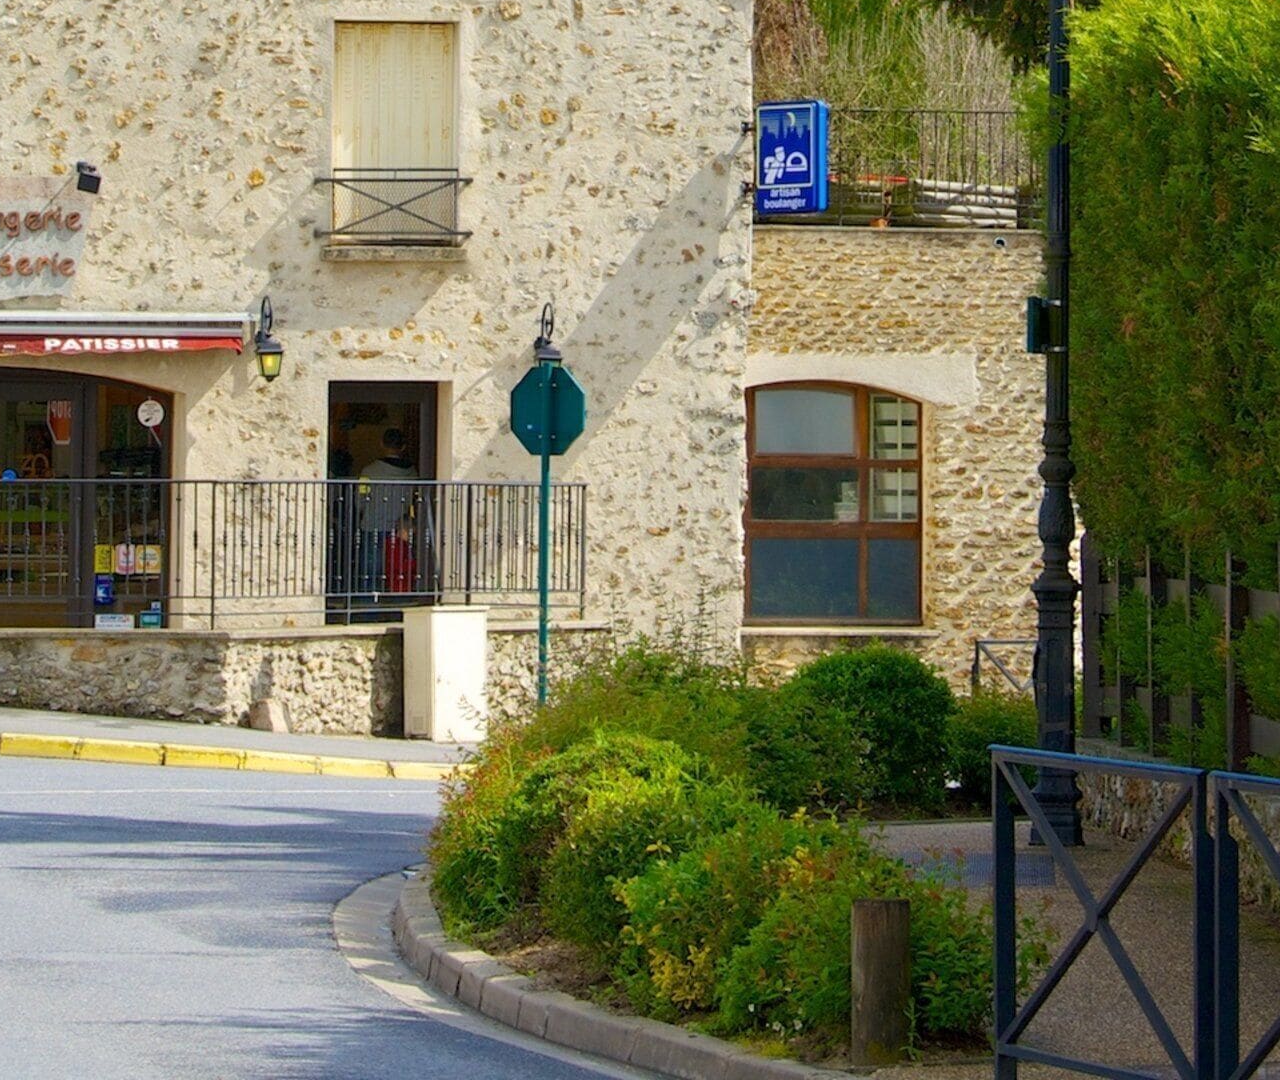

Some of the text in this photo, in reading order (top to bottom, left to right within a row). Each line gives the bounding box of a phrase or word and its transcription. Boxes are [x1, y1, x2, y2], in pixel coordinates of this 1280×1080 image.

[770, 188, 801, 197] artisan
[764, 199, 806, 210] boulanger
[43, 338, 180, 351] PATISSIER
